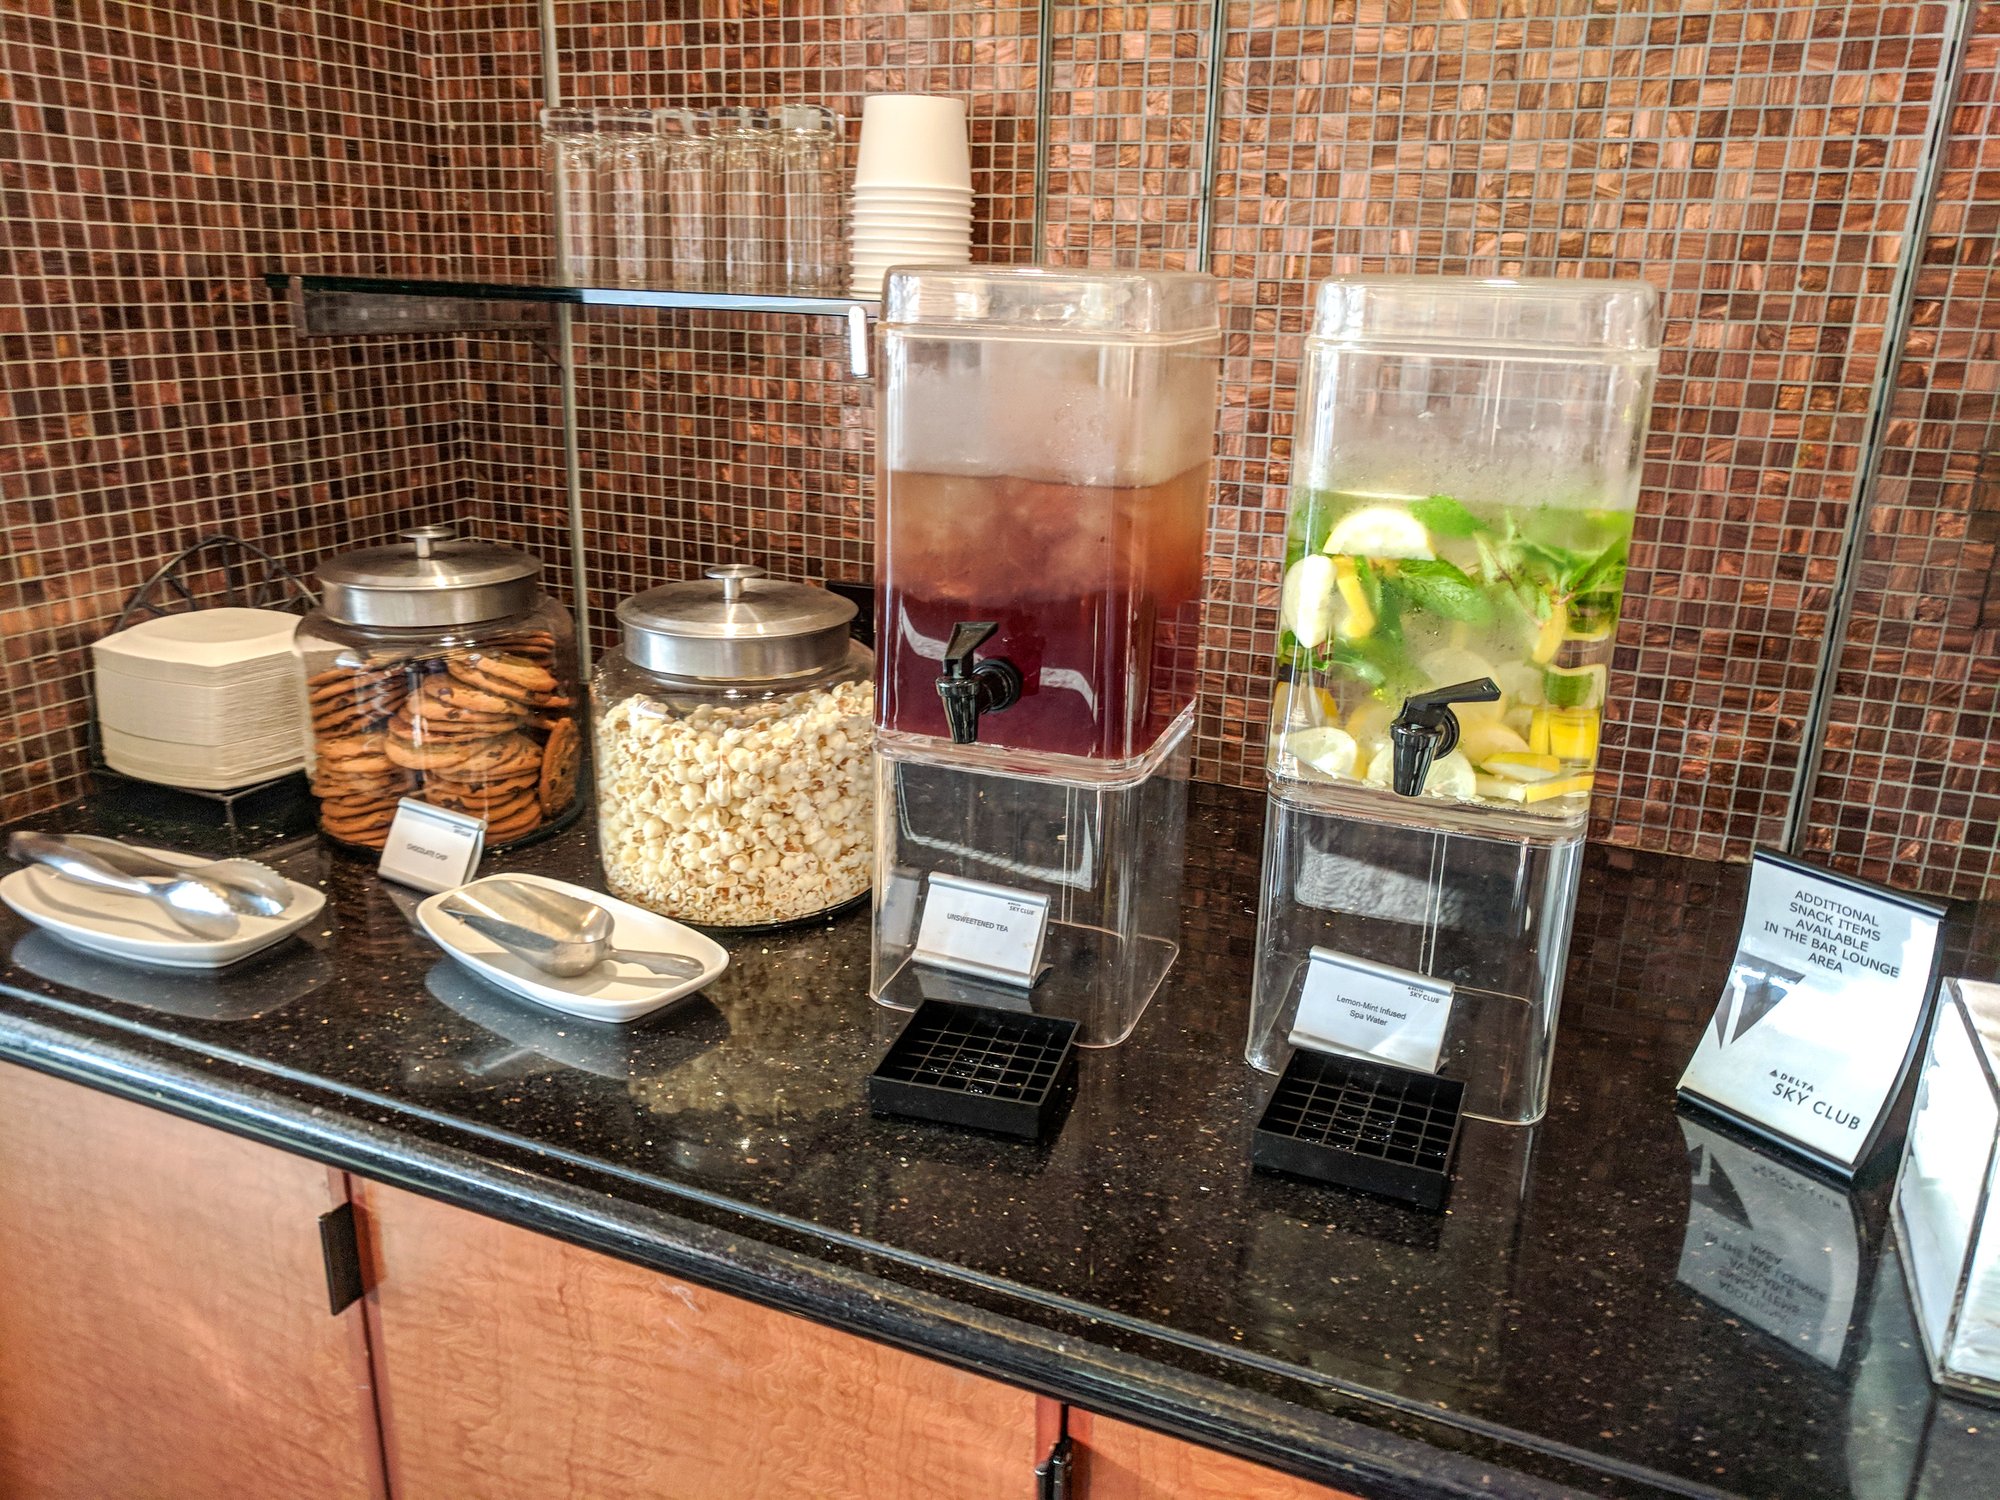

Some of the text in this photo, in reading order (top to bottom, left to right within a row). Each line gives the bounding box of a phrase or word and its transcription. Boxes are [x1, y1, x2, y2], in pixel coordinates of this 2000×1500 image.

[1794, 890, 1879, 927] ADDITIONAL
[946, 913, 1009, 933] UNSWEETENED TEA
[1789, 902, 1881, 942] SNACK ITEMS
[1795, 919, 1869, 952] AVAILABLE
[1764, 920, 1900, 978] IN THE BAR LOUNGE
[1808, 953, 1843, 974] AREA
[1336, 994, 1407, 1020] Lemon-Mint Infused
[1409, 990, 1440, 1004] SKY CLUB
[1349, 1009, 1388, 1026] Spa Water
[1780, 1073, 1814, 1093] DELTA
[1772, 1082, 1861, 1130] SKY CLUB
